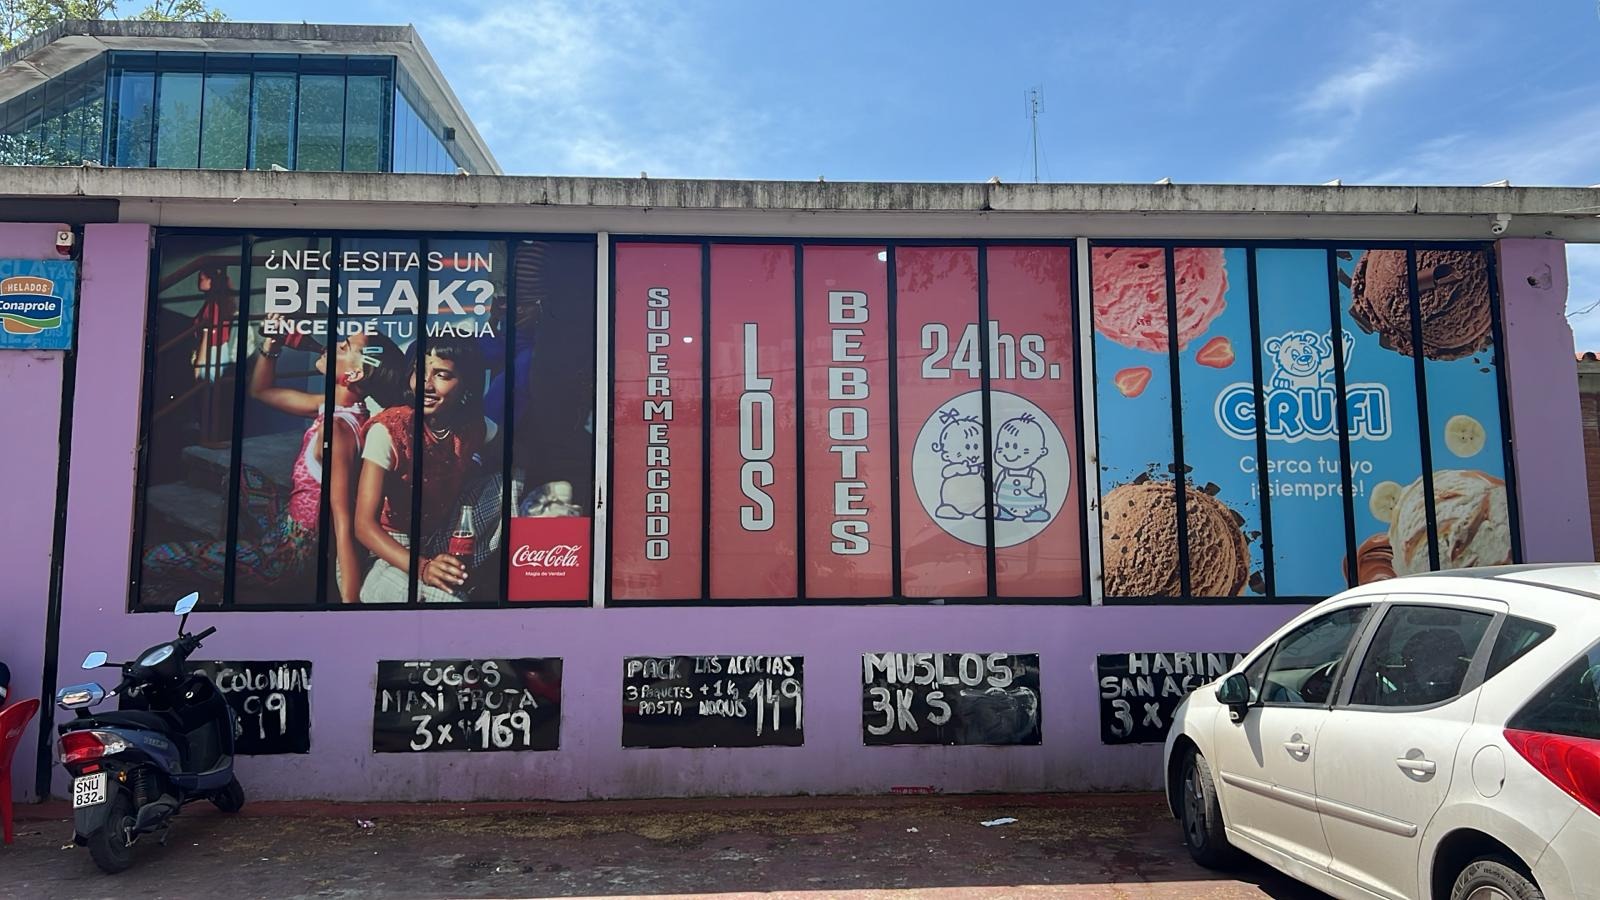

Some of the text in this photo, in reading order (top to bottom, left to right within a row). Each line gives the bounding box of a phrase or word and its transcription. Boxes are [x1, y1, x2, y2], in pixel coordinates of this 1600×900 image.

[264, 249, 493, 273] ¿NECESITAS UN
[7, 282, 48, 293] HELADOS
[264, 277, 495, 316] BREAK?
[263, 318, 495, 339] ENCENDÉ TU MAGIA
[643, 287, 673, 560] SUPERMERCADO
[828, 290, 870, 555] BEBOTES
[1216, 384, 1391, 441] CRUFI
[739, 322, 775, 532] LOS
[627, 656, 795, 679] PACK LAS ACACIAS
[864, 652, 1013, 688] MUSLOS
[626, 685, 639, 700] 3
[1100, 676, 1155, 699] SAN
[639, 700, 683, 716] PASTA
[76, 779, 99, 794] SNU
[76, 791, 98, 806] 832
